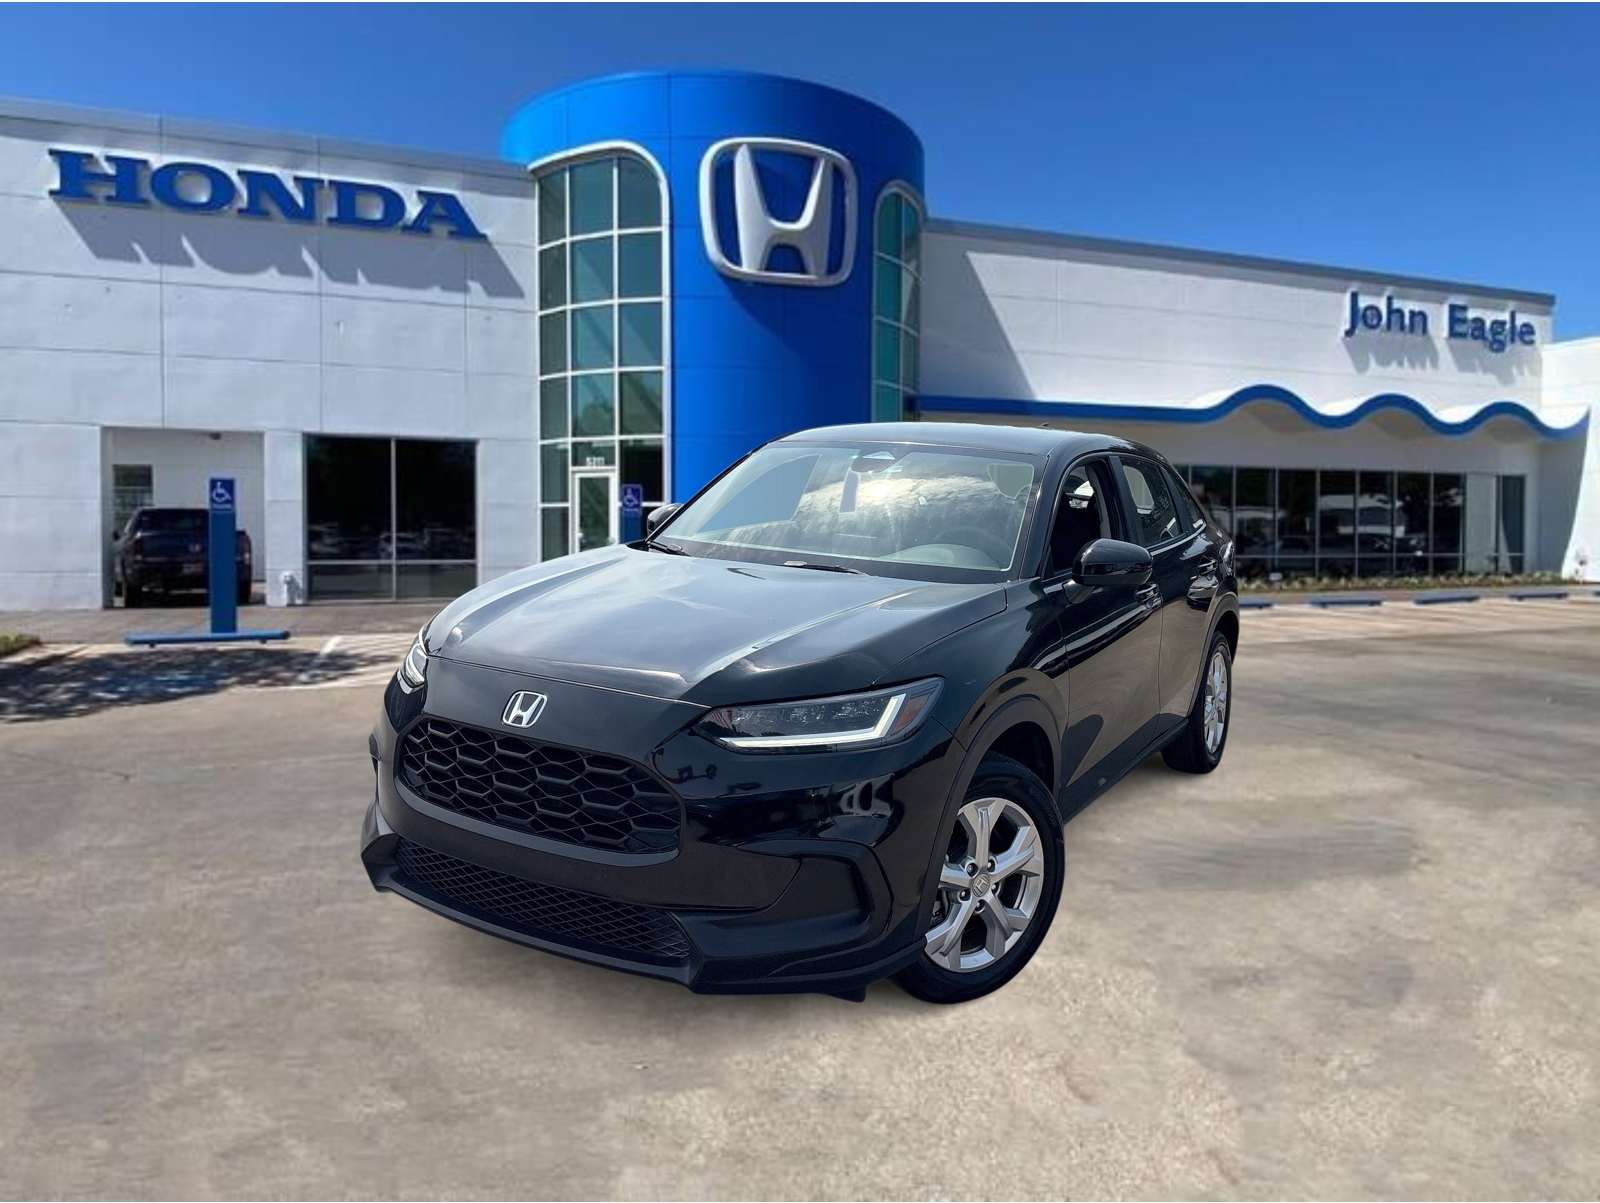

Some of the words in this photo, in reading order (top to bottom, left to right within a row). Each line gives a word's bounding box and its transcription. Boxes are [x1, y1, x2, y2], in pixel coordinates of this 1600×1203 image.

[48, 148, 488, 240] HONDA
[1344, 291, 1428, 338] John
[1448, 303, 1536, 353] Eagle
